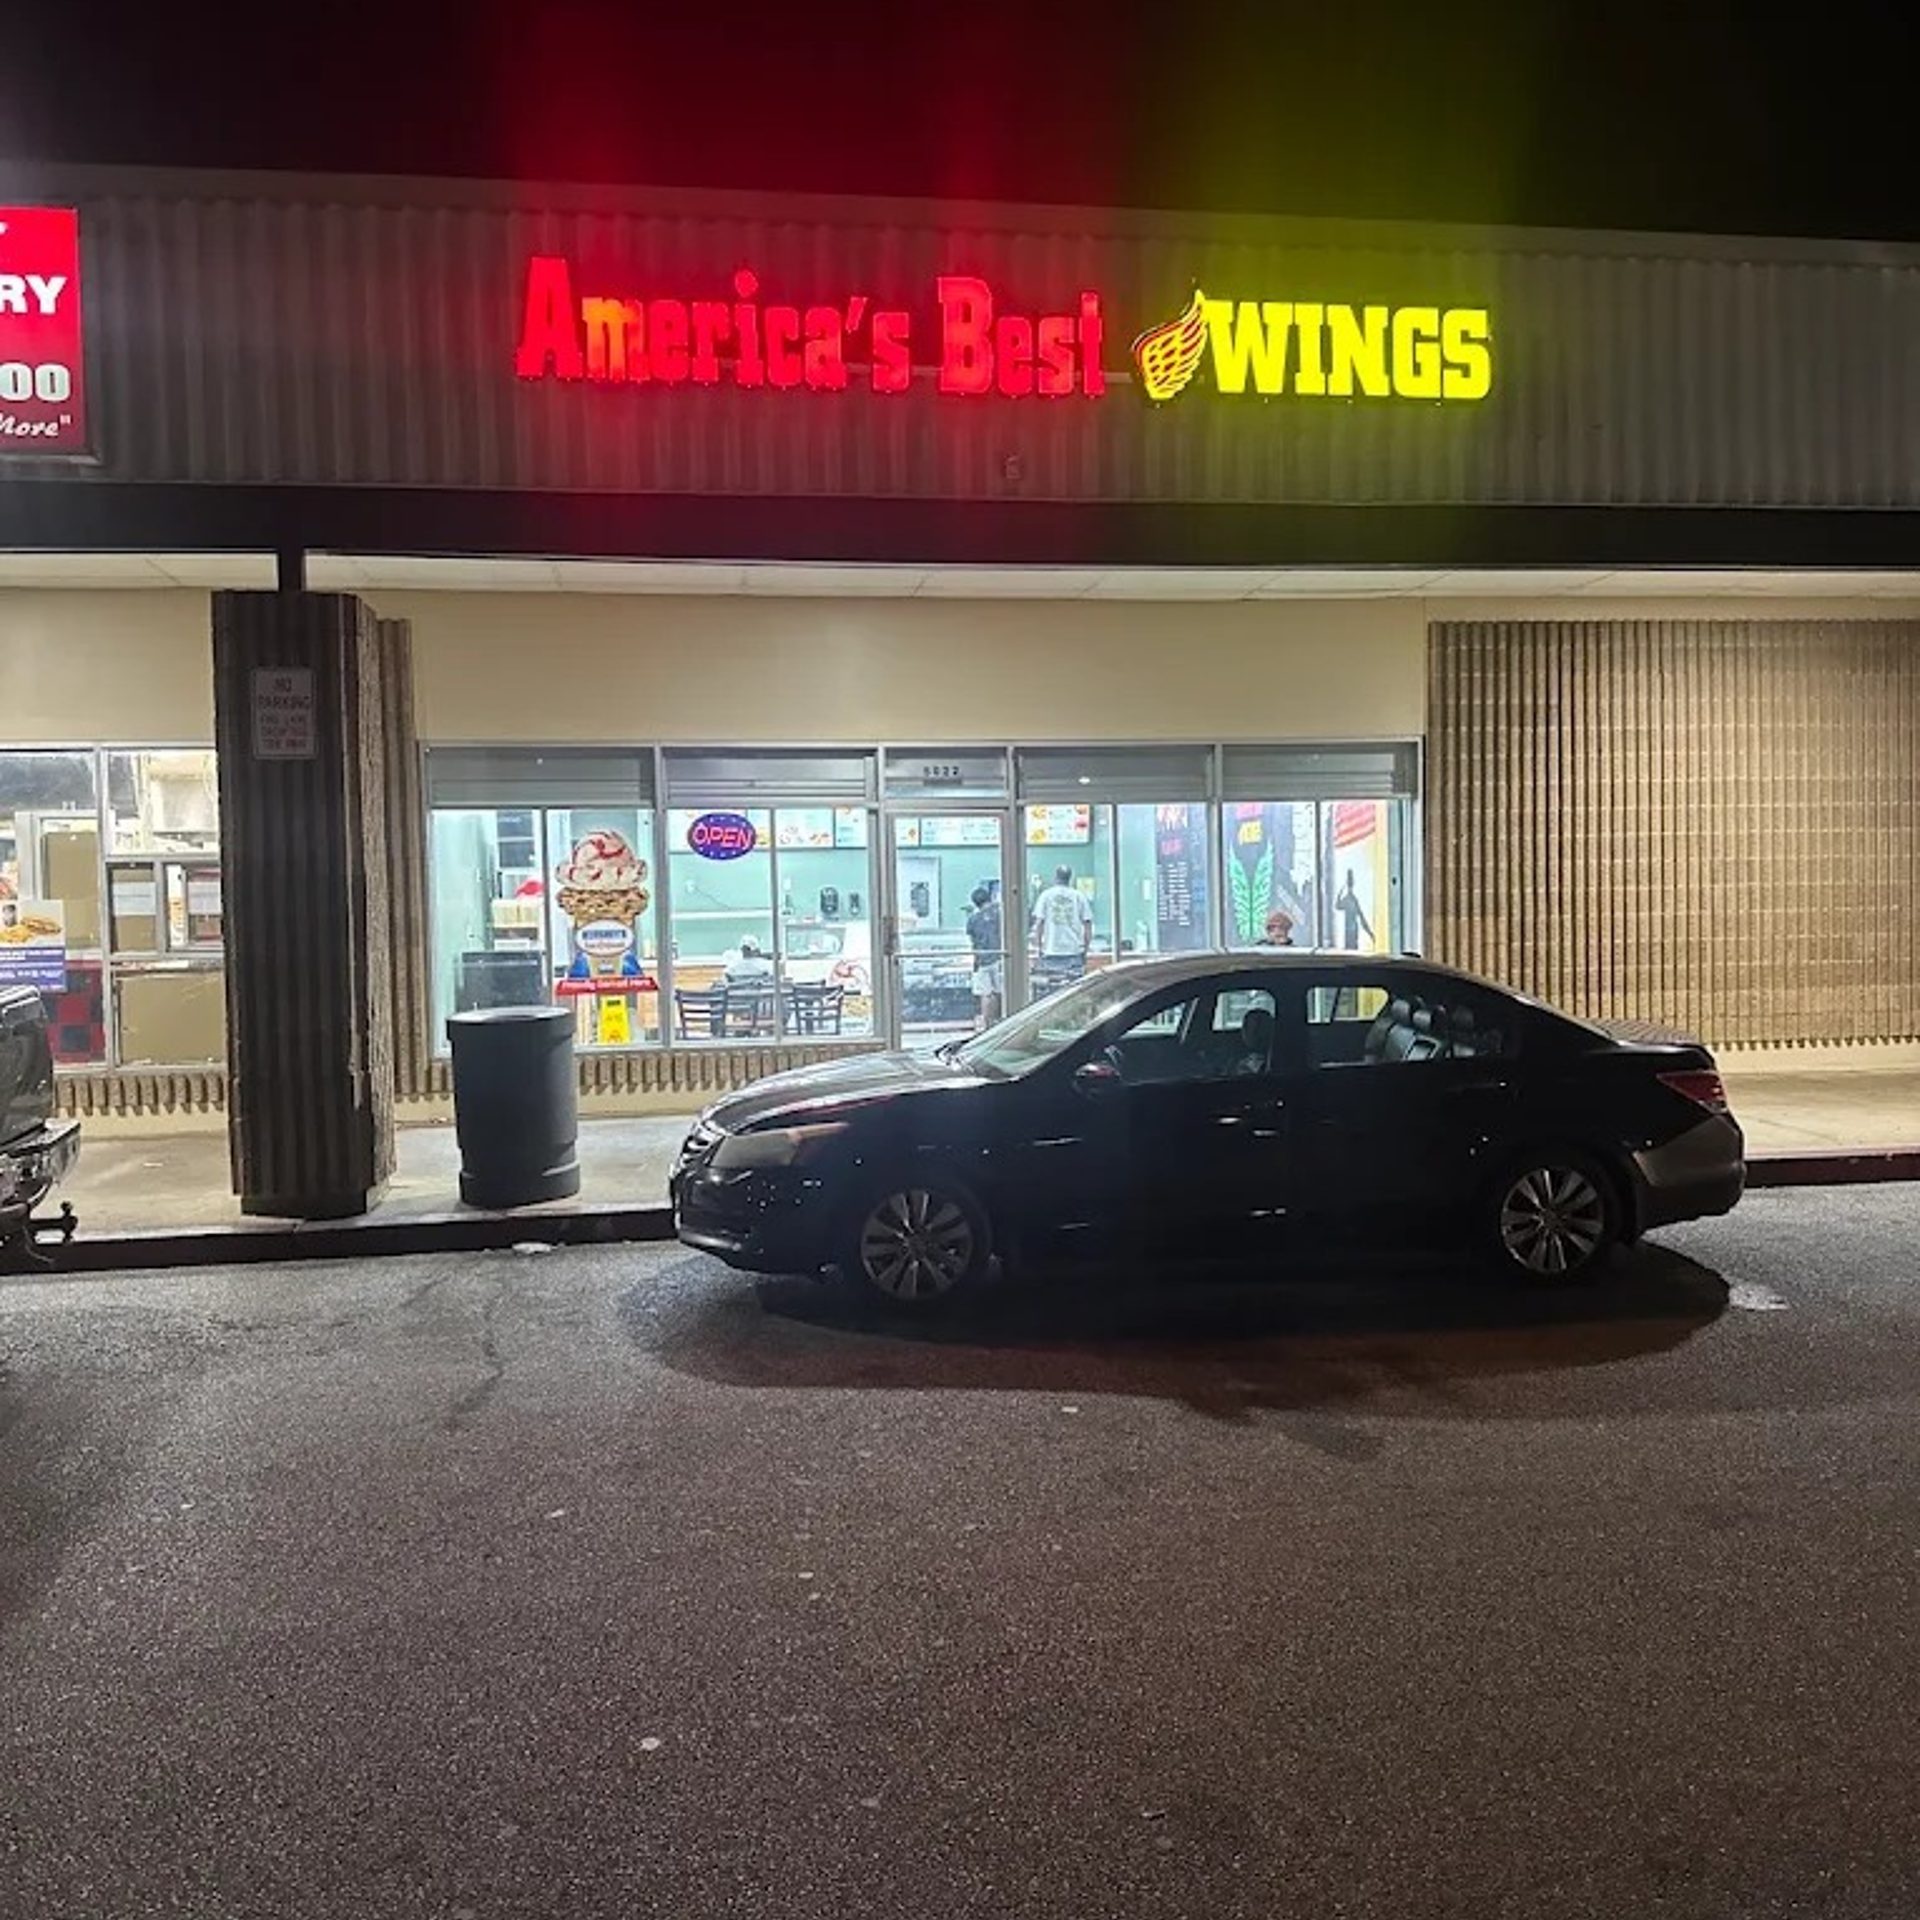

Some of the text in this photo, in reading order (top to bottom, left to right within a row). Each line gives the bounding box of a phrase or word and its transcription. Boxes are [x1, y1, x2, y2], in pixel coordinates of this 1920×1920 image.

[515, 256, 1105, 396] America's Best
[1201, 299, 1491, 399] WINGS
[692, 822, 753, 850] OPEN
